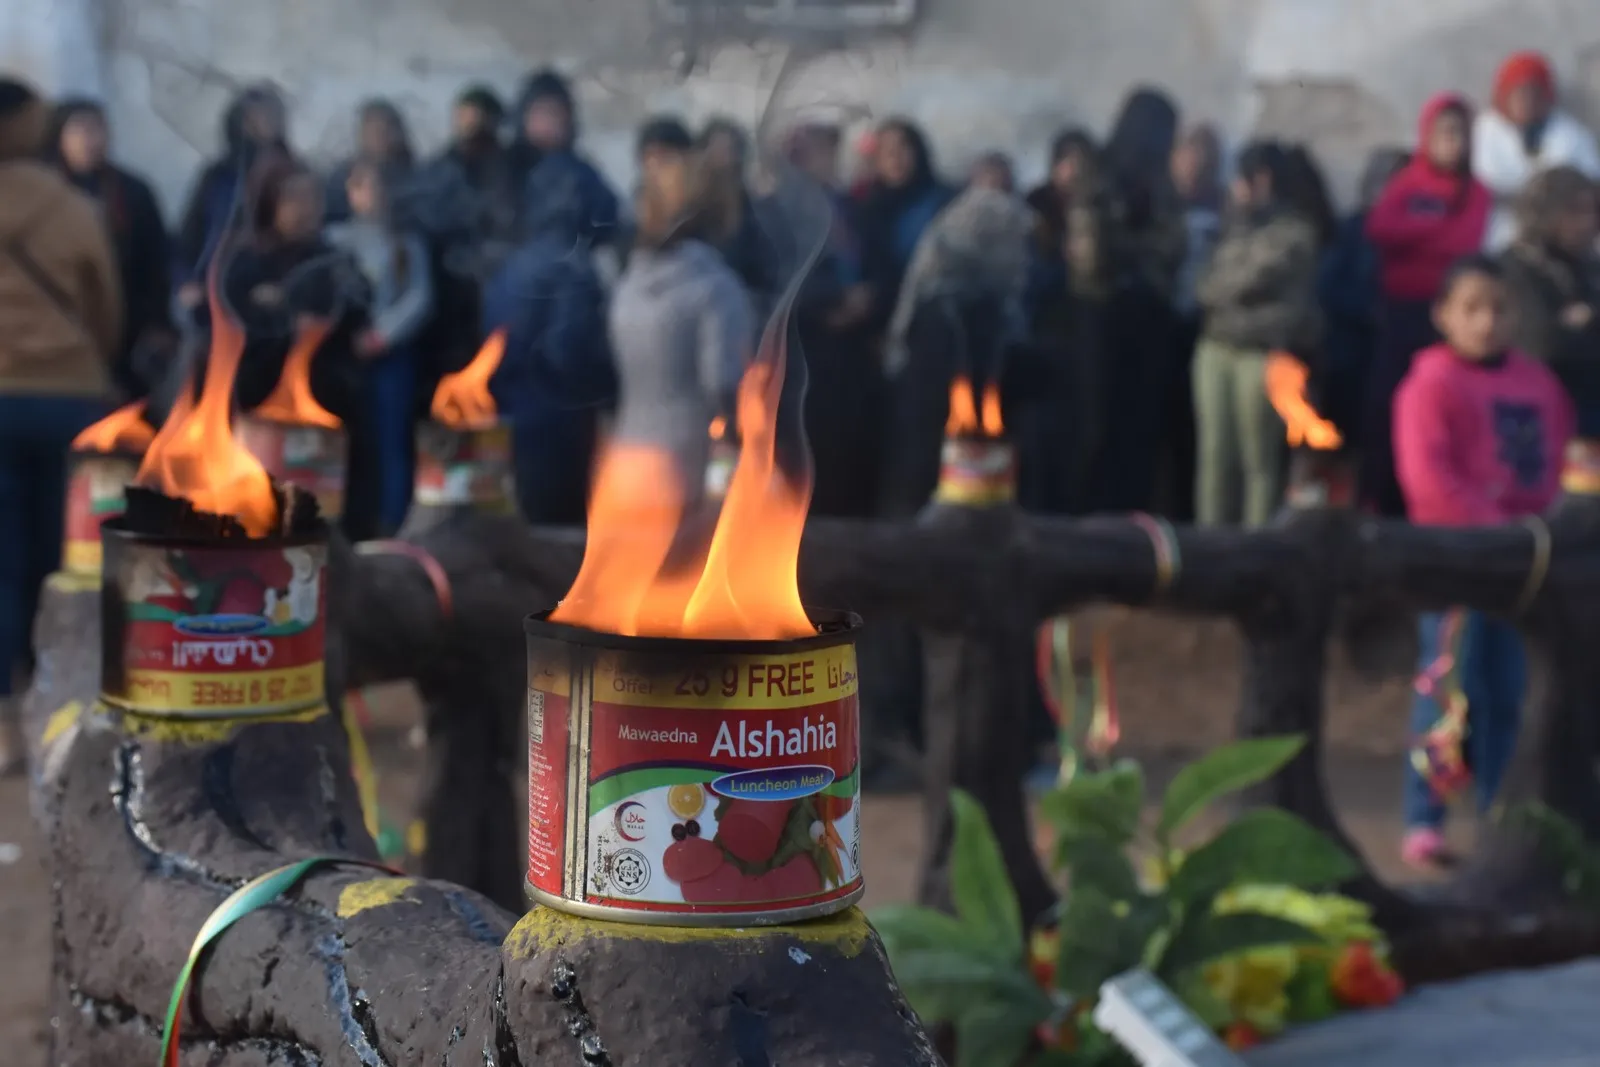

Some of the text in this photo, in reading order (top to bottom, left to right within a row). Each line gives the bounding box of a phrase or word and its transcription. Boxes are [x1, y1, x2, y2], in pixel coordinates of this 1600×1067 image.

[613, 677, 654, 695] Offer
[674, 664, 711, 697] 25
[721, 663, 739, 698] g
[748, 660, 815, 698] FREE
[617, 714, 837, 759] Mawaedna Alshahia
[730, 772, 825, 793] Luncheon Meat
[620, 870, 638, 880] SNS
